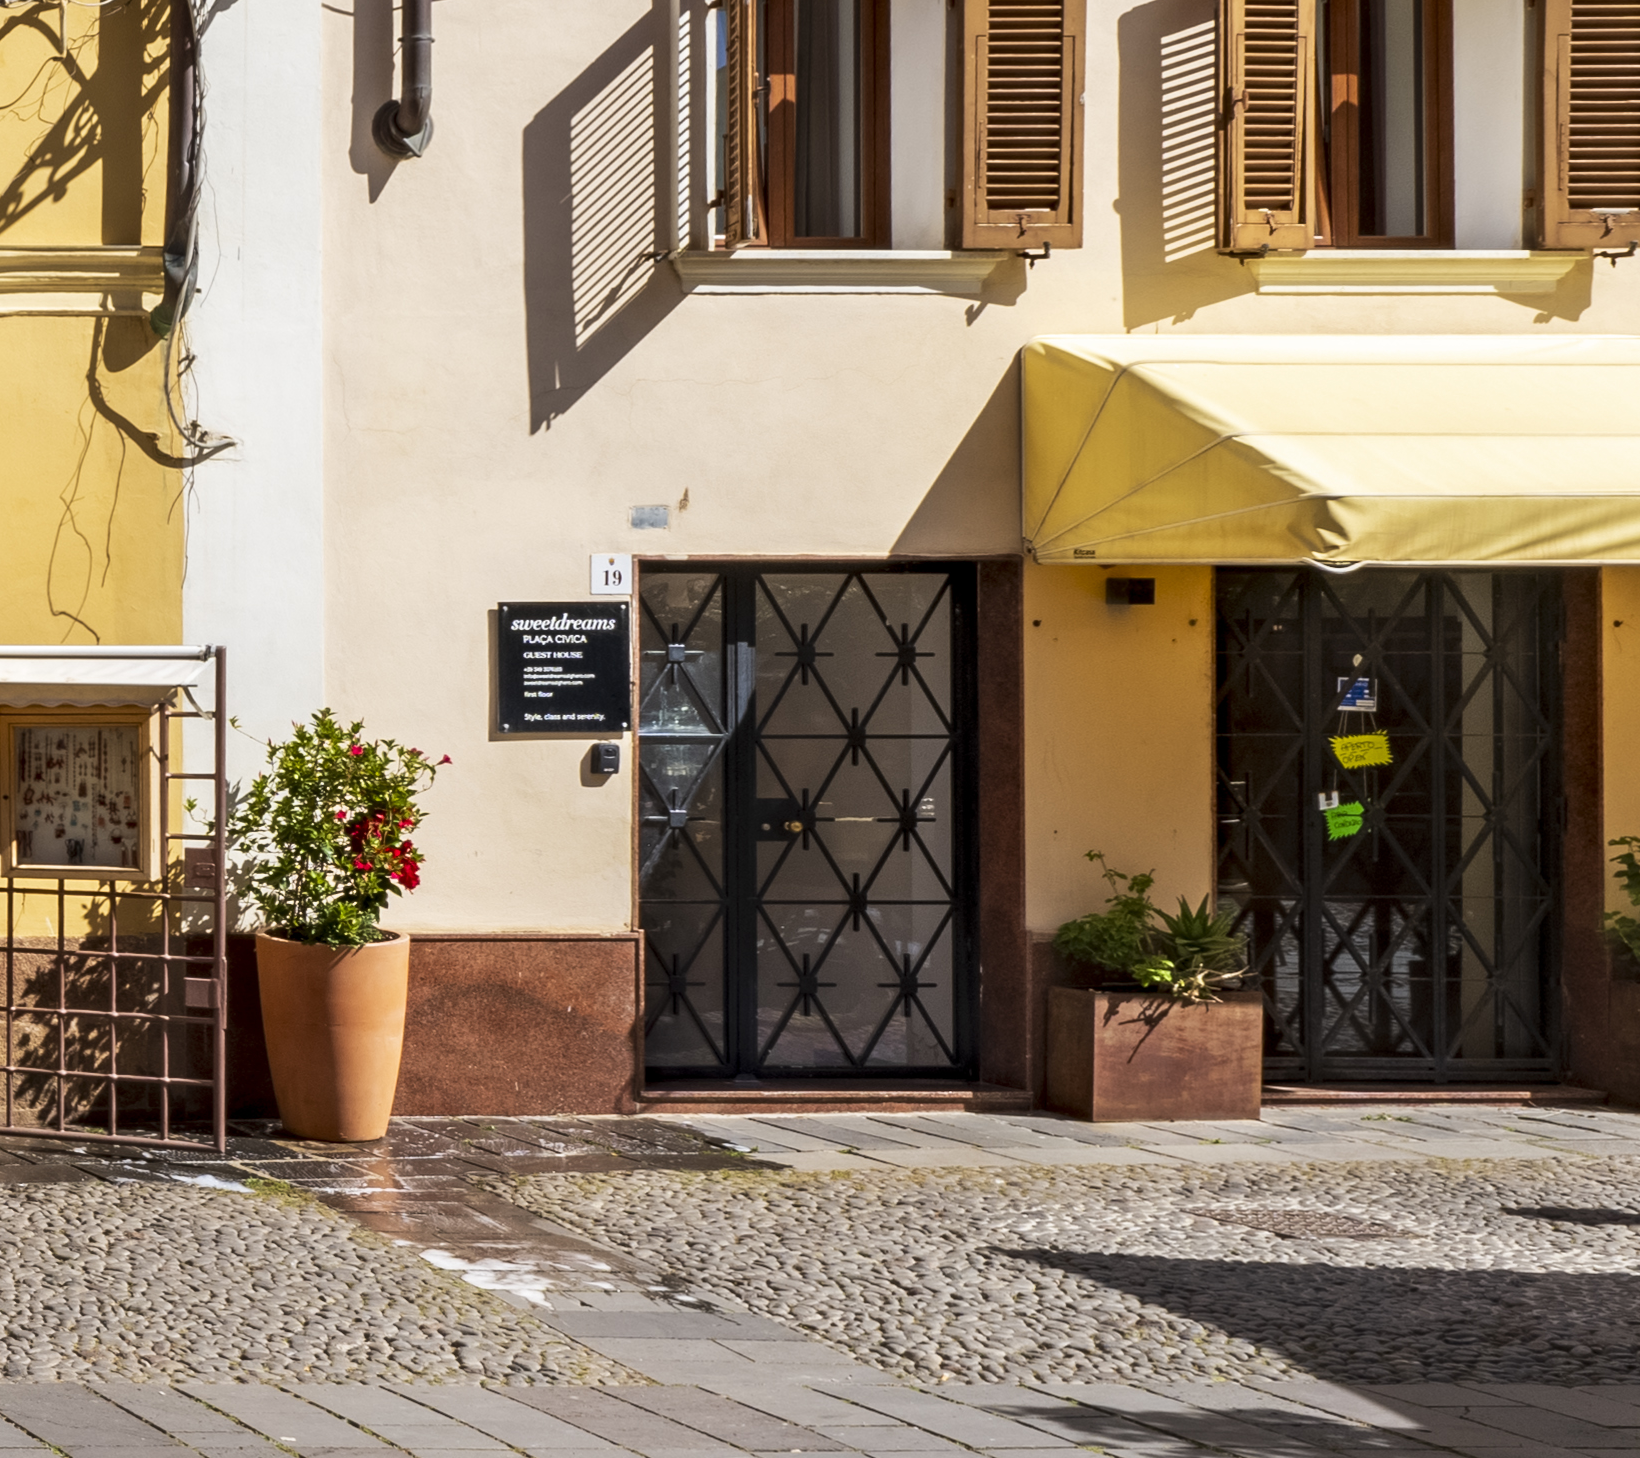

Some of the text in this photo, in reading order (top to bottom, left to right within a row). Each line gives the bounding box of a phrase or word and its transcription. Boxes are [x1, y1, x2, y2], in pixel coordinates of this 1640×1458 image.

[603, 569, 623, 586] 19
[510, 612, 616, 630] sweetdreams
[523, 635, 587, 645] PLAÇA CIVICA
[523, 651, 583, 659] GUEST HOUSE
